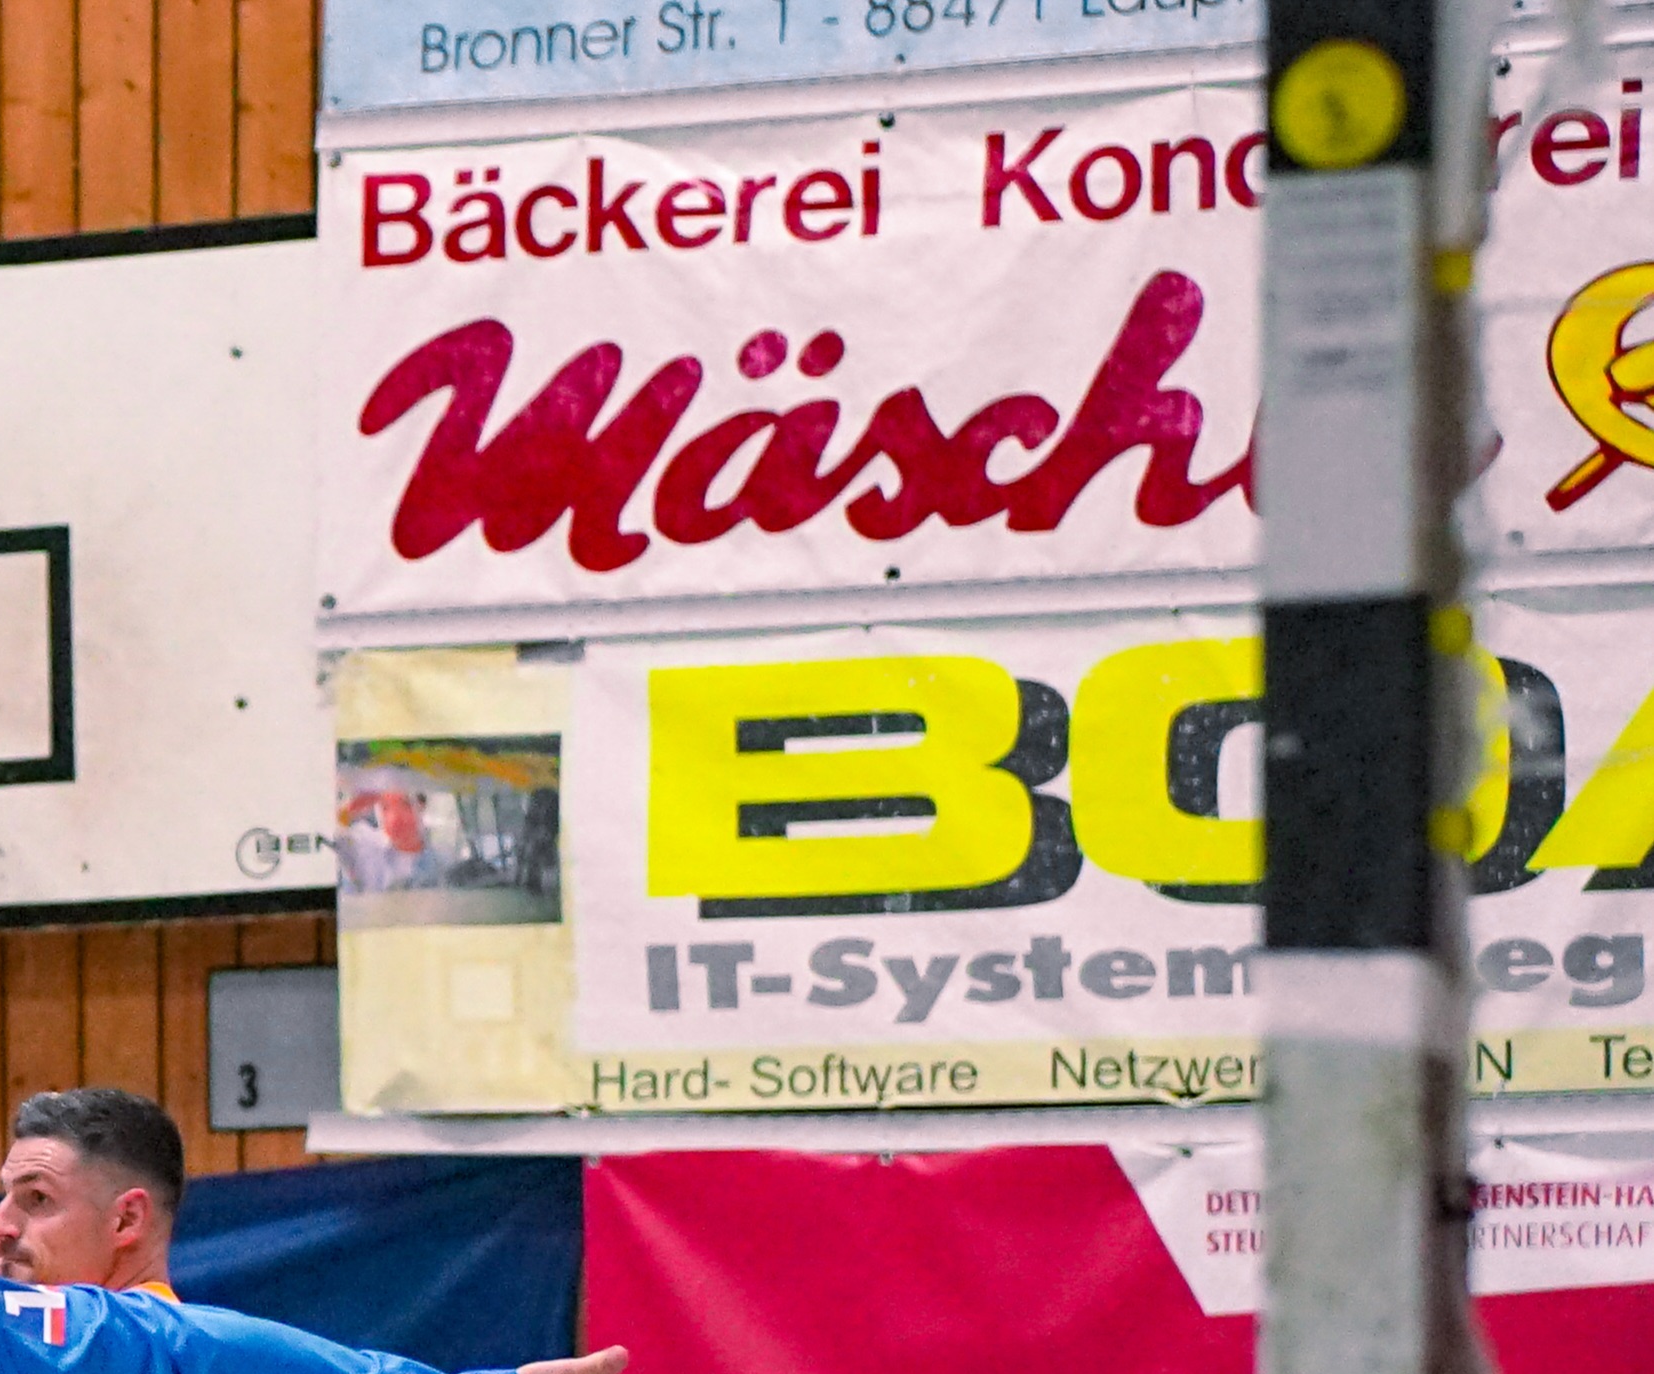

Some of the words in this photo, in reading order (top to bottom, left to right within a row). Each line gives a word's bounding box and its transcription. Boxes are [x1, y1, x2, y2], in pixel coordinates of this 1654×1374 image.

[420, 17, 635, 73] Bronner
[359, 138, 883, 268] Bäckerei
[358, 268, 1264, 575] Mäsch
[237, 1061, 258, 1109] 3
[591, 1054, 731, 1104] Hard-
[751, 1046, 979, 1102] Software
[1050, 1042, 1266, 1098] Netzwer
[1206, 1230, 1263, 1256] STEU
